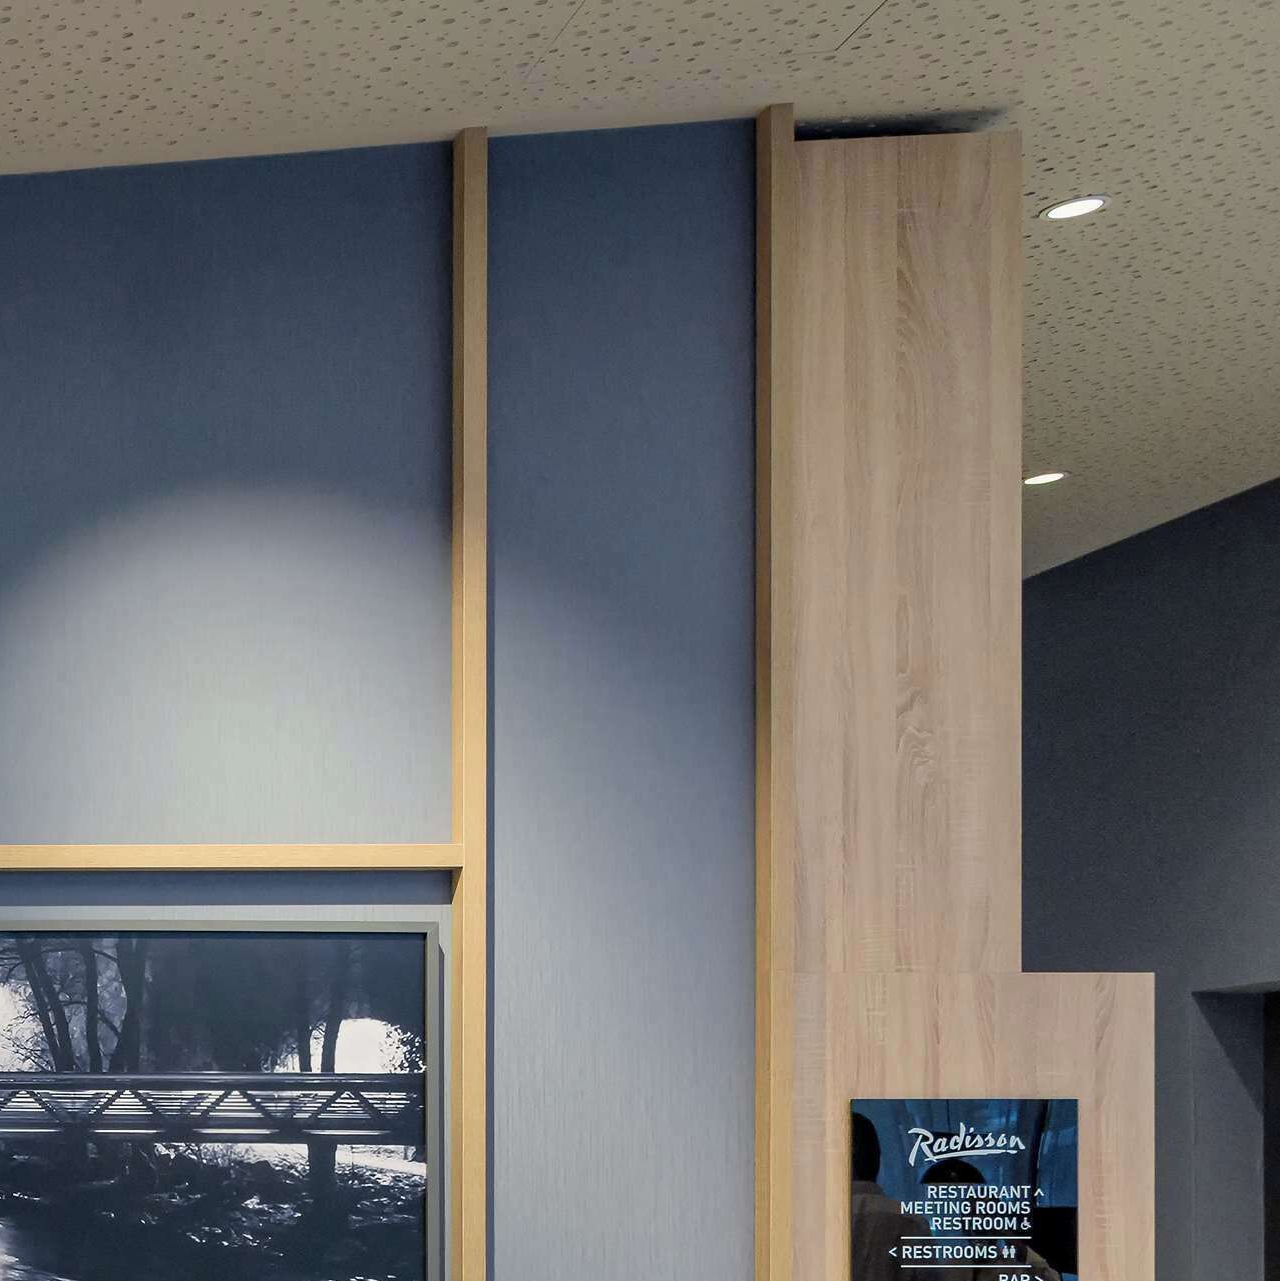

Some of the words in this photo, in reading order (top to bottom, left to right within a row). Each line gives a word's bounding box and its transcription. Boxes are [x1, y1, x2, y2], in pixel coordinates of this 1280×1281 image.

[907, 1122, 1026, 1167] Radisson
[927, 1185, 1031, 1199] RESTAURANT
[900, 1201, 971, 1215] MEETING
[975, 1201, 1031, 1215] ROOMS
[932, 1217, 1017, 1230] RESTROOM
[902, 1246, 998, 1259] RESTROOMS
